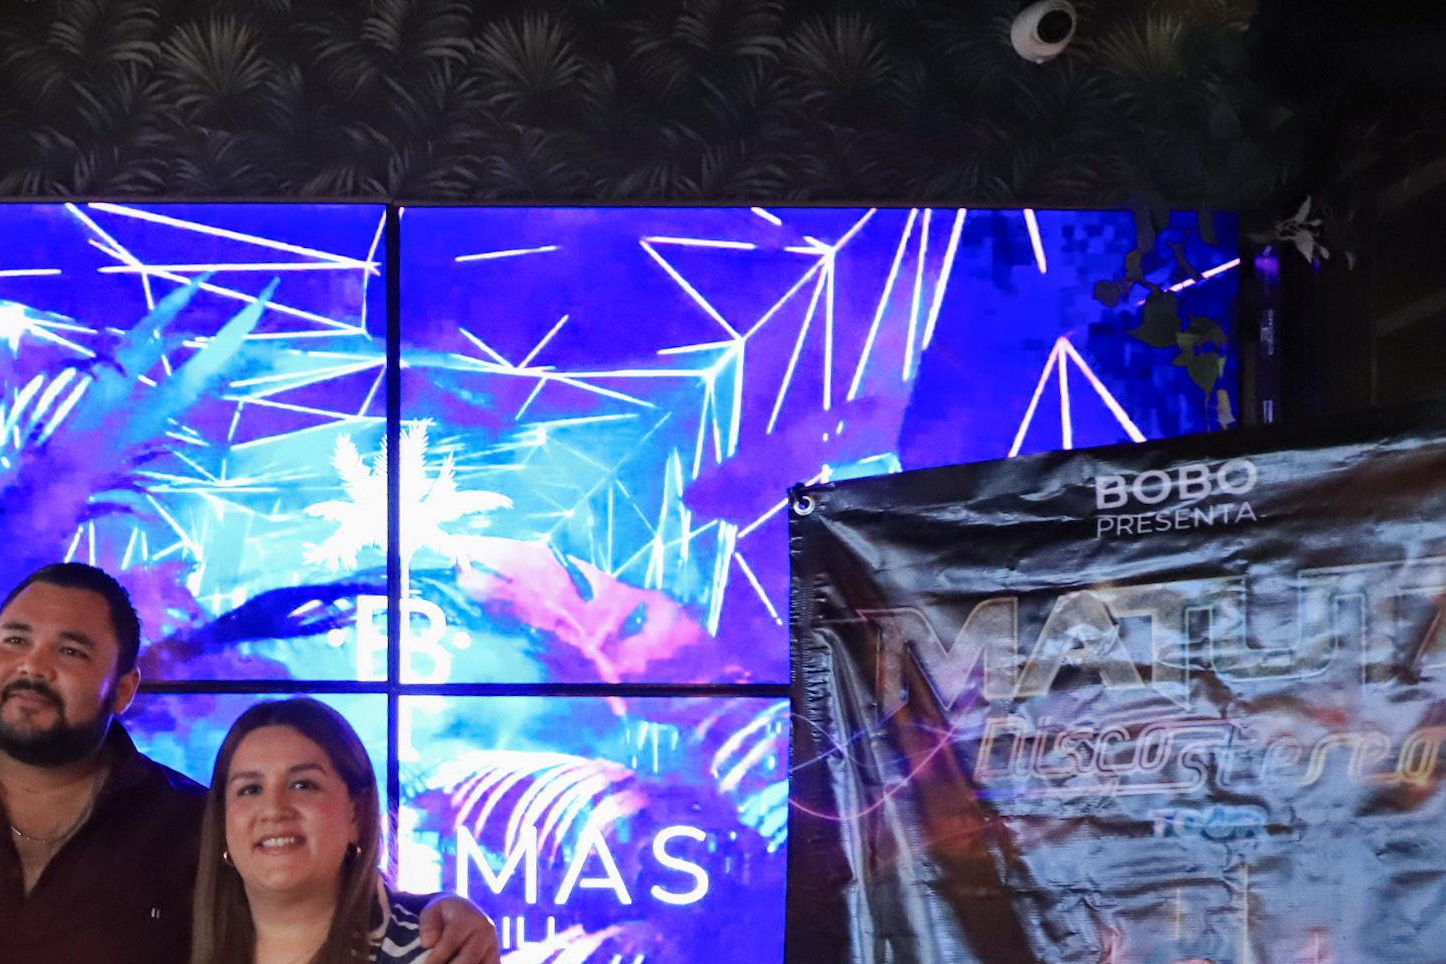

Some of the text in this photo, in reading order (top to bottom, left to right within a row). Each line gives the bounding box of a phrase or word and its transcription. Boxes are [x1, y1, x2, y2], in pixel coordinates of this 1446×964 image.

[1095, 458, 1258, 510] BOBO
[1096, 501, 1258, 540] PRESENTA
[857, 557, 1446, 712] MATUT
